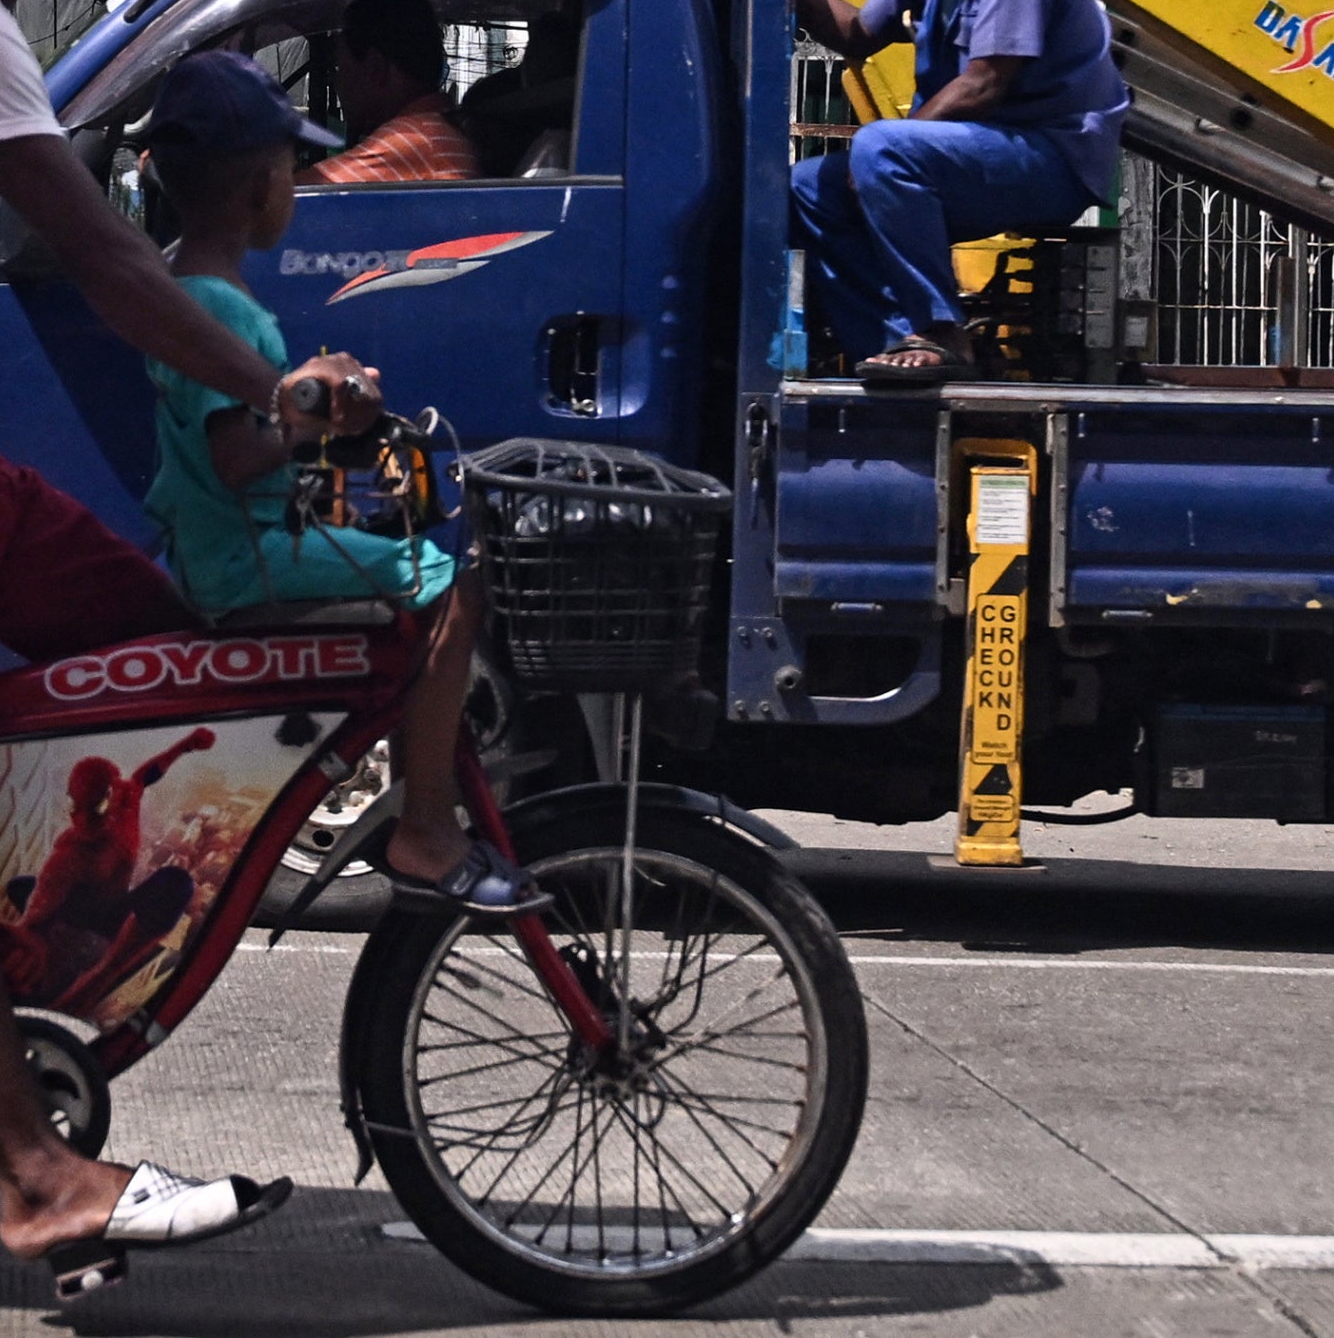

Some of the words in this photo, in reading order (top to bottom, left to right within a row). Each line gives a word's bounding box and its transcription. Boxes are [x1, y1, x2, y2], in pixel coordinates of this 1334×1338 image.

[44, 634, 371, 701] COYOTE
[979, 605, 995, 708] CHECK
[997, 605, 1016, 731] GROUND
